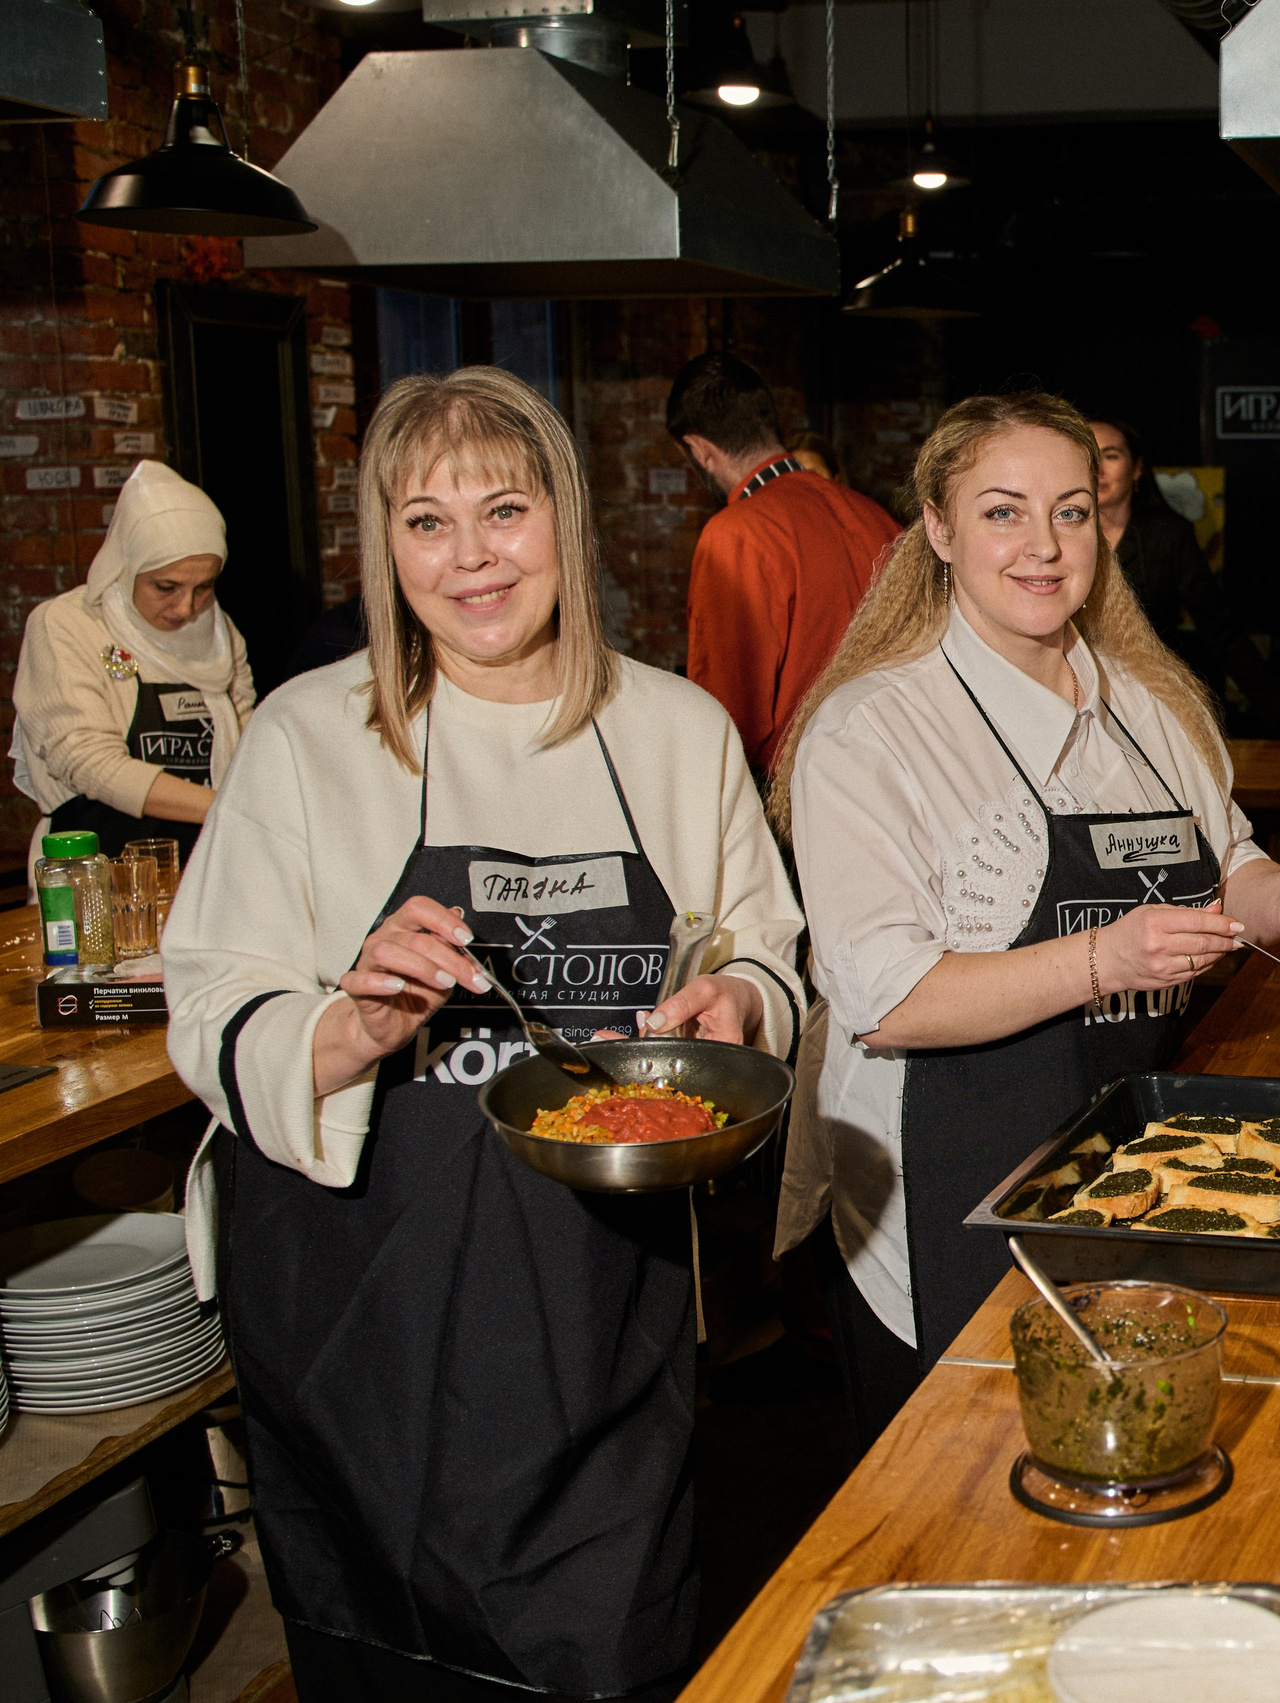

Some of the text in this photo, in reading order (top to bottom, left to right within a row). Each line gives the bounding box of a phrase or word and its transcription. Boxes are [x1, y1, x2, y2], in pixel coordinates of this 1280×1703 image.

[1105, 833, 1181, 856] Аннушка
[511, 953, 664, 986] СТОЛОВ
[93, 987, 128, 996] Перчатки
[557, 990, 620, 1001] СТУДИЯ
